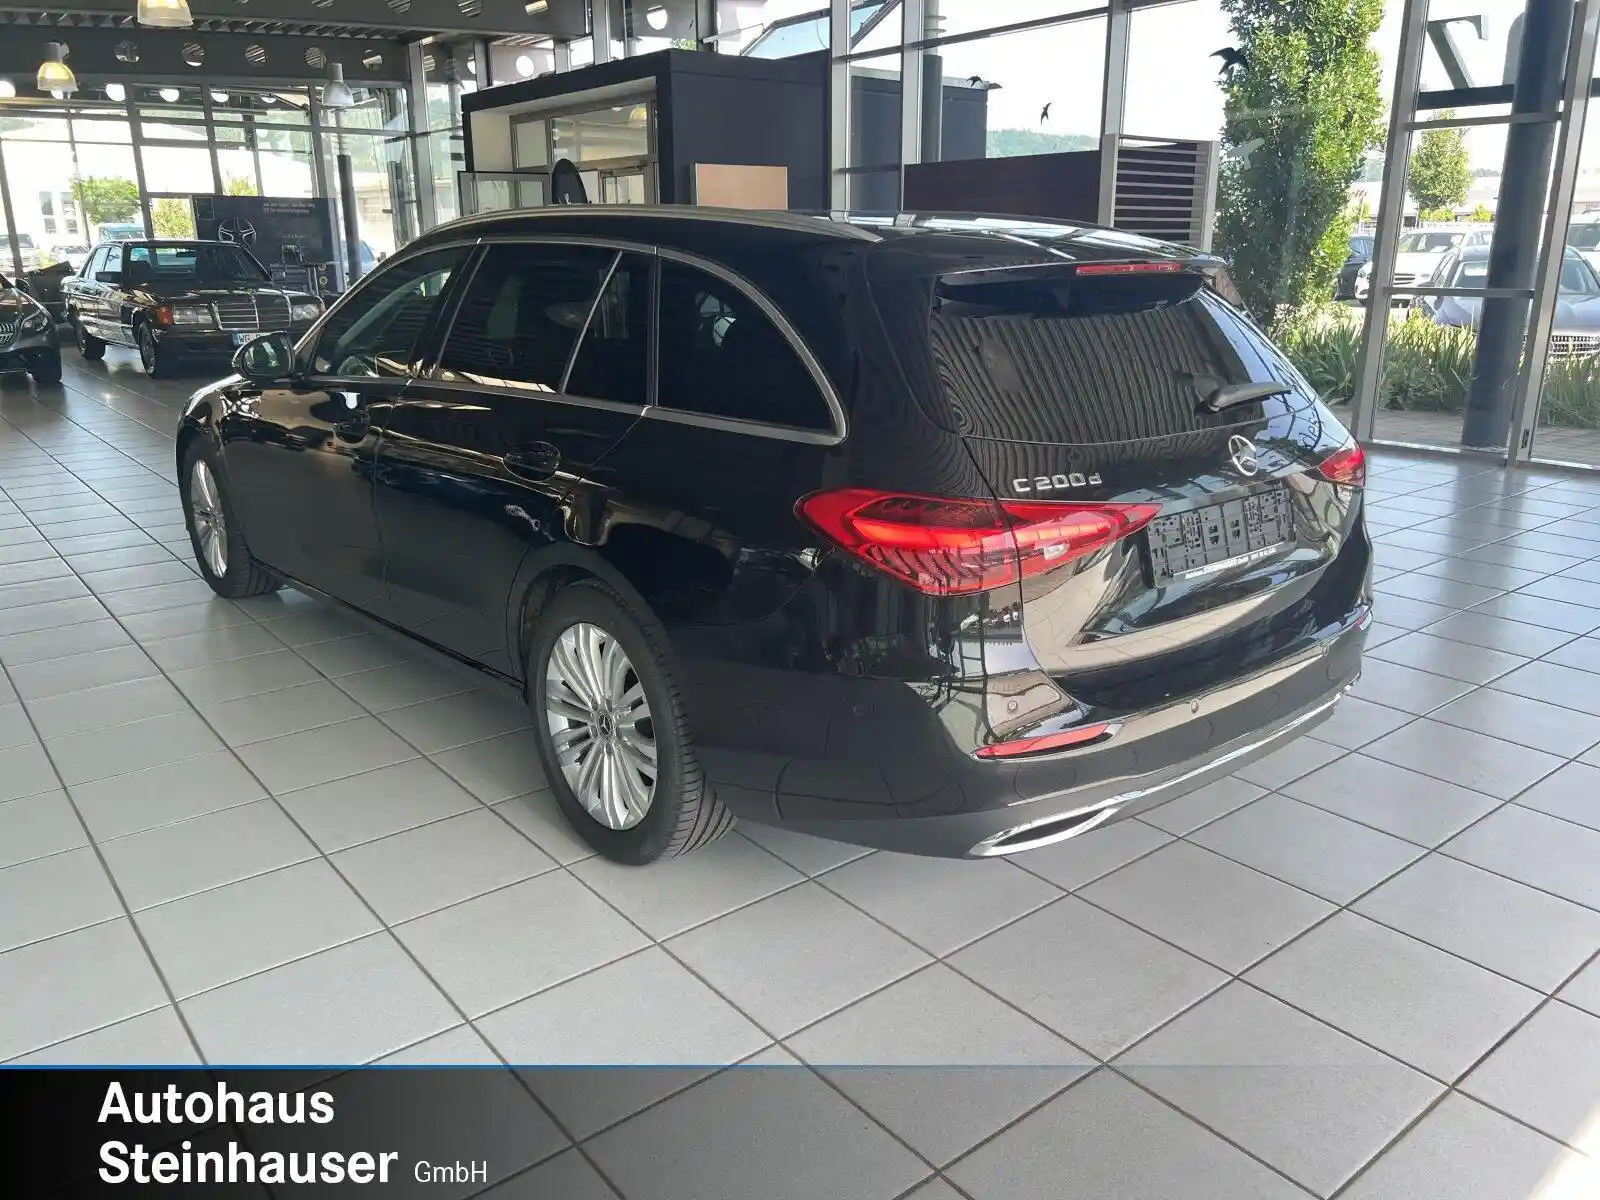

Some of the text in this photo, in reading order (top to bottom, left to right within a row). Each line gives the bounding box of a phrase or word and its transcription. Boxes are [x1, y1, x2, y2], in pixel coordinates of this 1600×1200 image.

[1012, 472, 1102, 492] C 200 d
